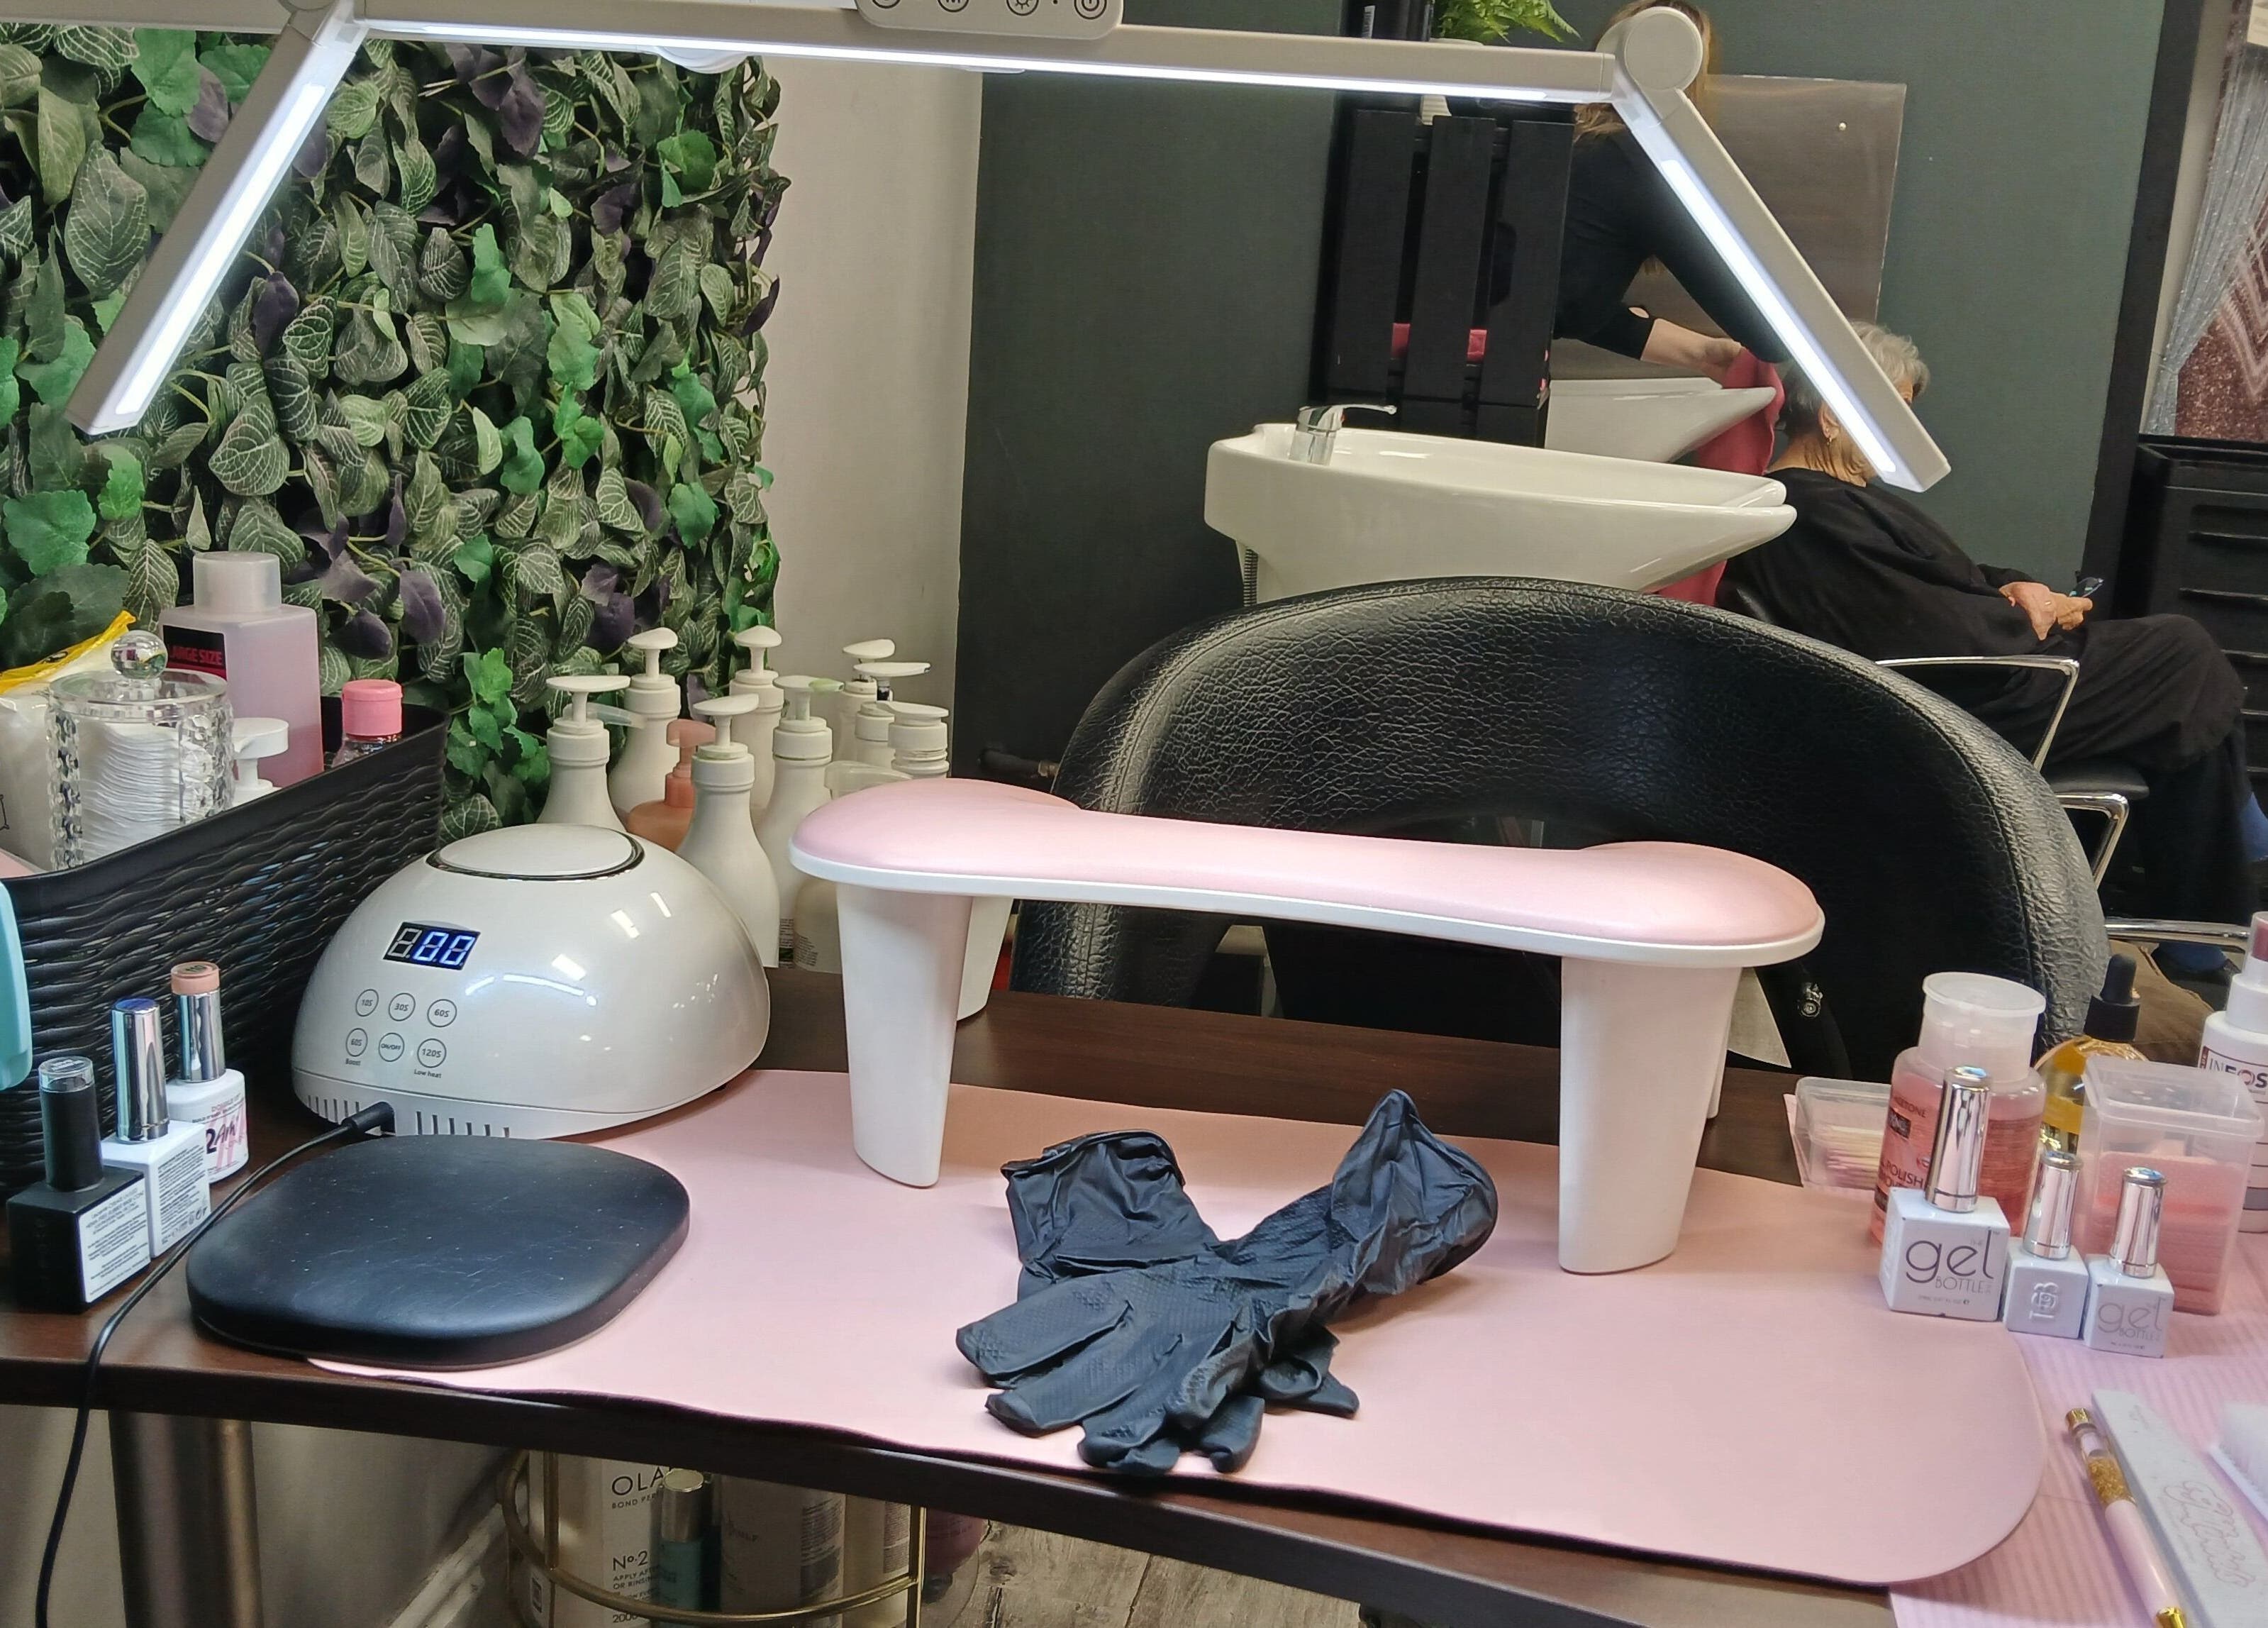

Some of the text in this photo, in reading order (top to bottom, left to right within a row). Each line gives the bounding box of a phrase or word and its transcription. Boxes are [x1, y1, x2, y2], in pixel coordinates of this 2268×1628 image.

[199, 648, 223, 665] SIZE
[394, 1002, 409, 1012] 30S
[433, 1008, 450, 1018] 60S
[421, 1048, 442, 1058] 120S
[427, 1070, 442, 1079] heat
[1886, 1161, 1924, 1188] POLISH
[1906, 1229, 1994, 1284] gel
[1935, 1276, 1985, 1294] BOTTLE
[2099, 1296, 2162, 1334] gel
[611, 1466, 664, 1496] OLA
[612, 1498, 638, 1510] BOND
[613, 1571, 637, 1582] APPLY
